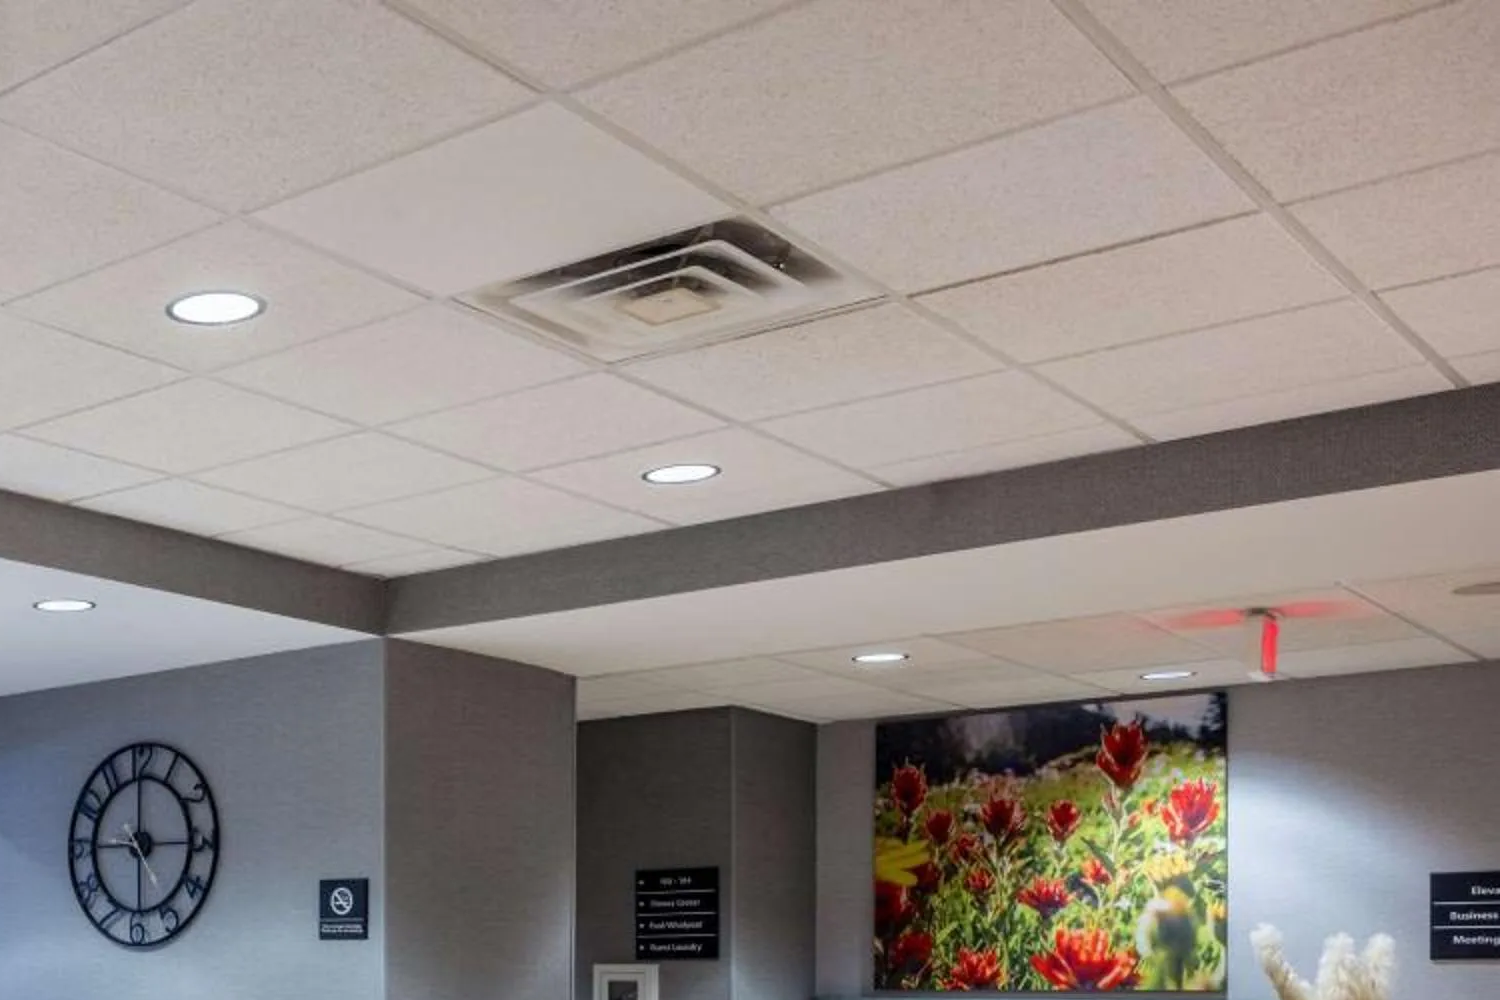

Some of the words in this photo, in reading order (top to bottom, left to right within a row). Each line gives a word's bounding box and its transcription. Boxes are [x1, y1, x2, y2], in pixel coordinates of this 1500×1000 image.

[132, 744, 154, 779] 12
[129, 910, 146, 944] 6
[160, 906, 180, 934] 5
[1449, 911, 1499, 921] Business
[1453, 935, 1500, 946] Meeting
